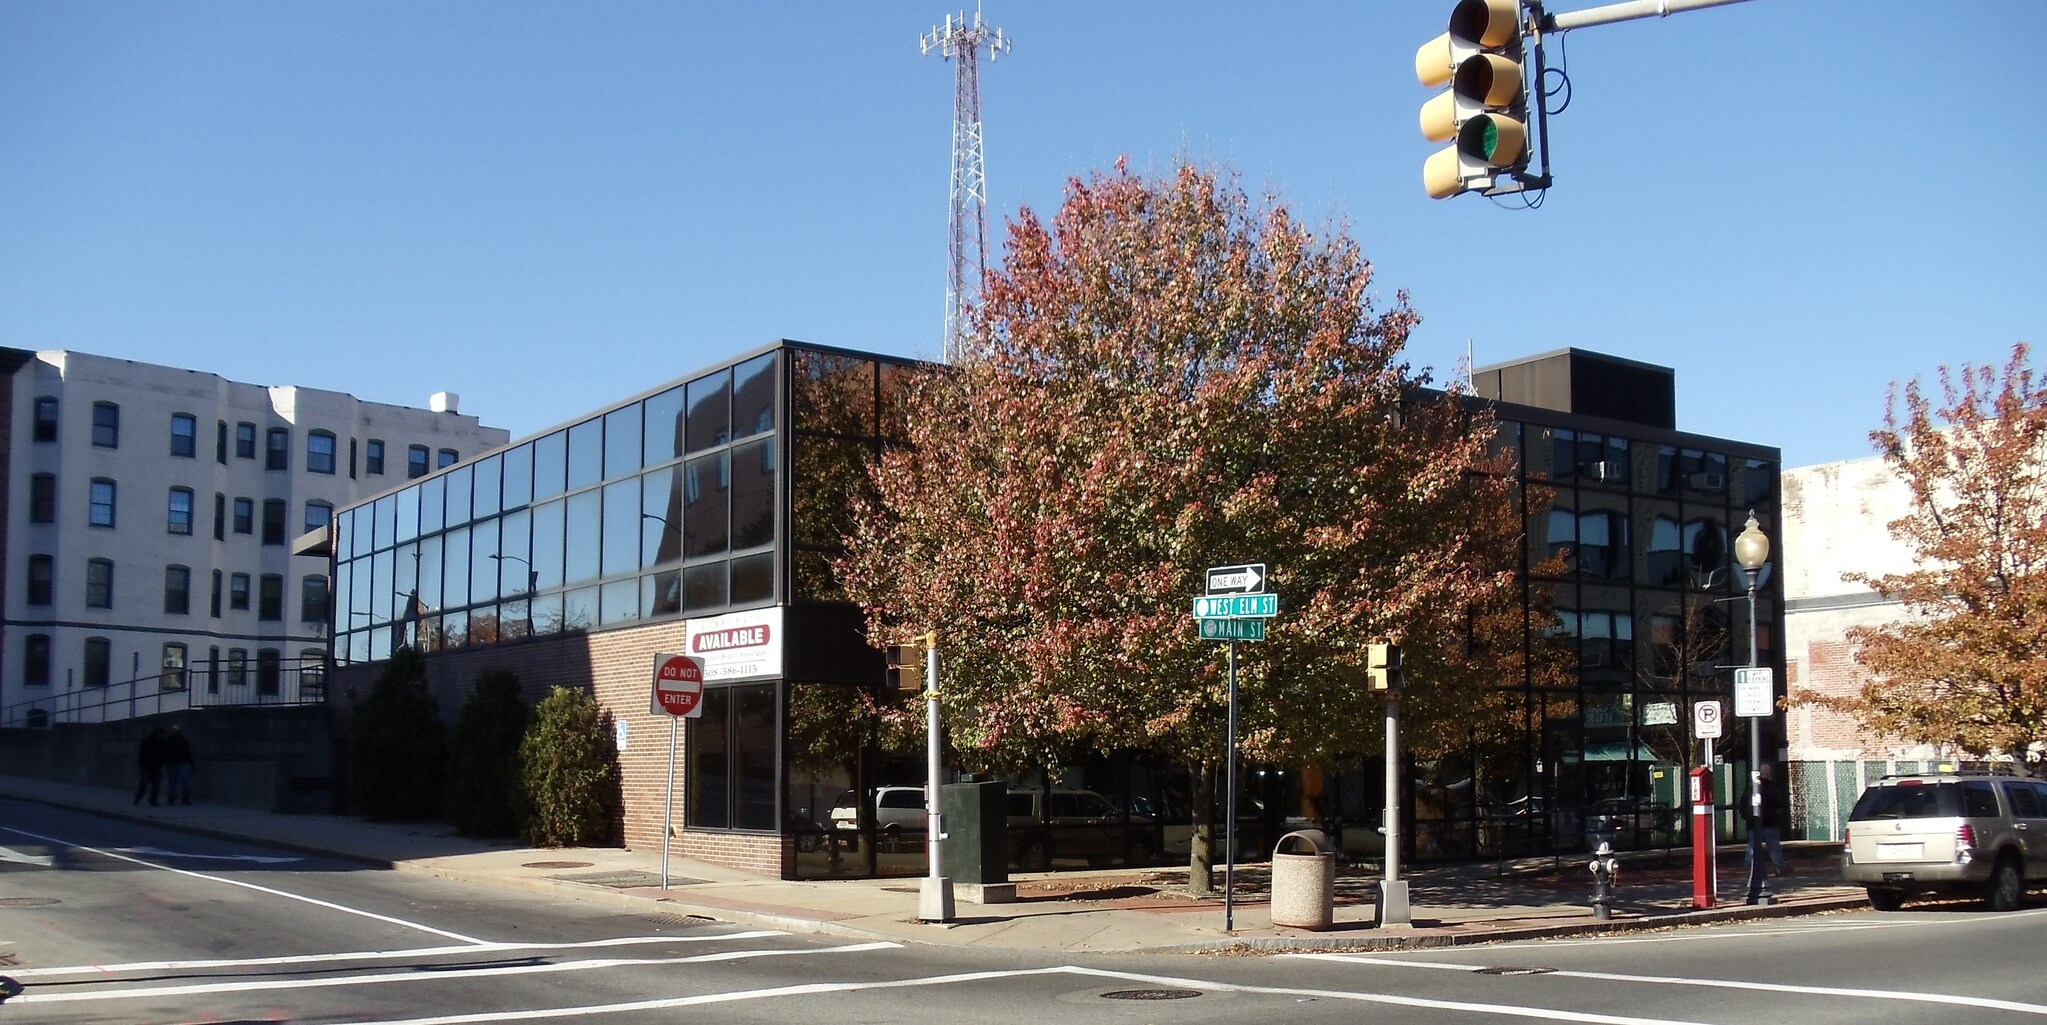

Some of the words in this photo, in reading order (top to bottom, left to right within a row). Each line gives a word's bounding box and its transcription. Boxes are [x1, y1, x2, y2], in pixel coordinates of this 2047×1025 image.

[1212, 577, 1228, 587] ONE
[1230, 575, 1248, 586] WAY
[1209, 599, 1235, 615] WEST
[1239, 598, 1258, 614] ELM
[1262, 597, 1274, 614] ST
[1218, 621, 1243, 637] MAIN
[1250, 622, 1262, 637] ST
[698, 628, 764, 650] AVAILABLE
[664, 666, 676, 677] DO
[680, 668, 698, 678] NOT
[664, 694, 692, 705] ENTER
